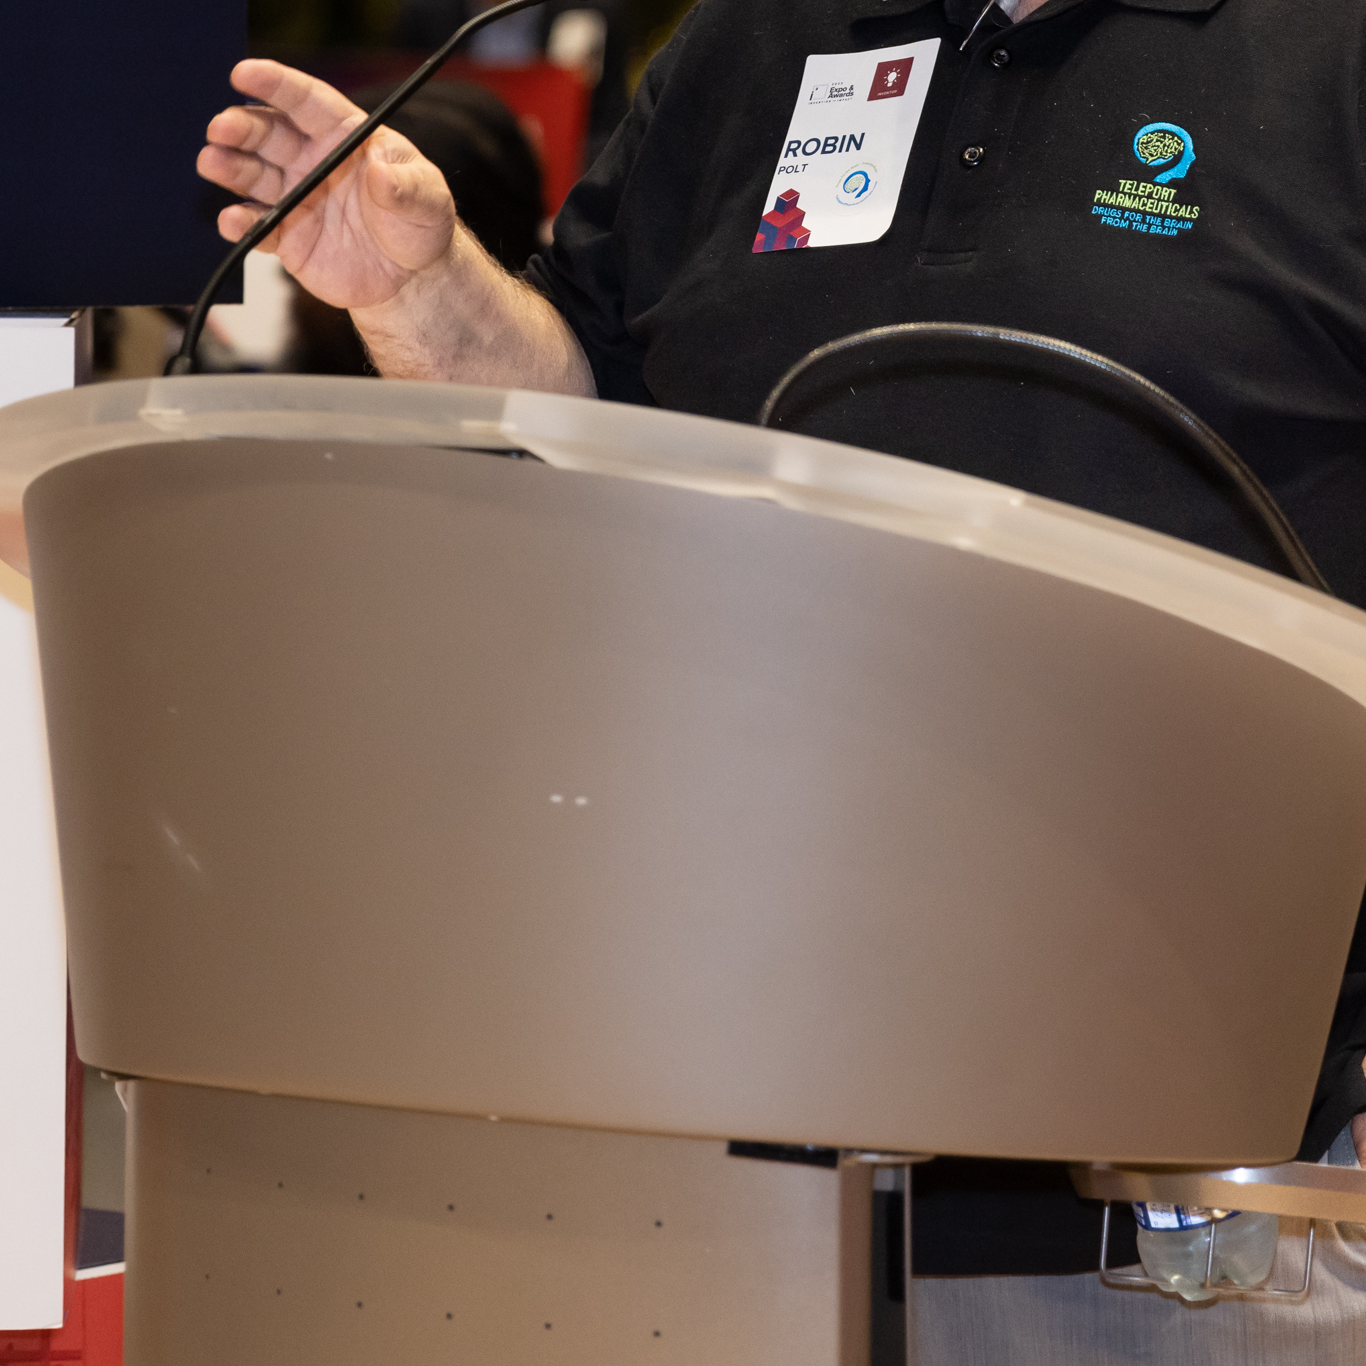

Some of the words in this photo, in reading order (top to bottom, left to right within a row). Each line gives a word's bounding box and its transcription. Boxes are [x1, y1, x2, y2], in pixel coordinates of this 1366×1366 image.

[784, 132, 865, 158] ROBIN
[778, 163, 808, 175] POLT
[1119, 179, 1177, 201] TELEPORT
[1094, 190, 1200, 219] PHARMACEUTICALS
[1091, 205, 1122, 218] DRUGS
[1124, 211, 1143, 222] FOR
[1145, 215, 1162, 226] THE
[1164, 218, 1193, 230] BRAIN
[1100, 216, 1129, 228] FROM
[1131, 222, 1148, 232] THE
[1149, 225, 1178, 236] BRAIN
